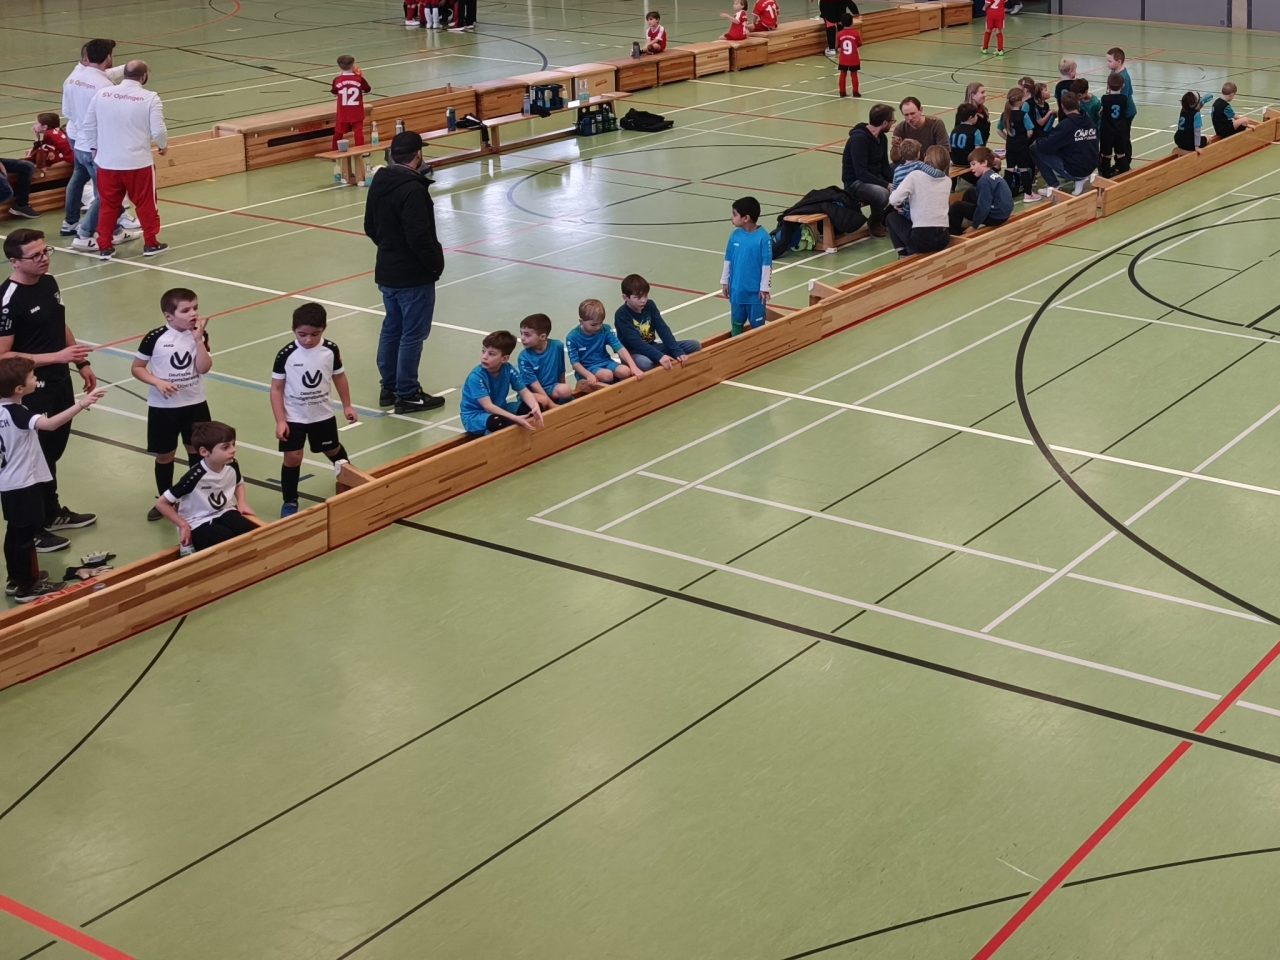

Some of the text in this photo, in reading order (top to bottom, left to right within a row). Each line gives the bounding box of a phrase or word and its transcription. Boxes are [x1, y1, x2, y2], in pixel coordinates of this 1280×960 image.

[842, 39, 853, 55] 9
[113, 94, 145, 102] Opfingen
[338, 87, 360, 106] 12
[1110, 104, 1121, 119] 3
[951, 133, 968, 149] 10
